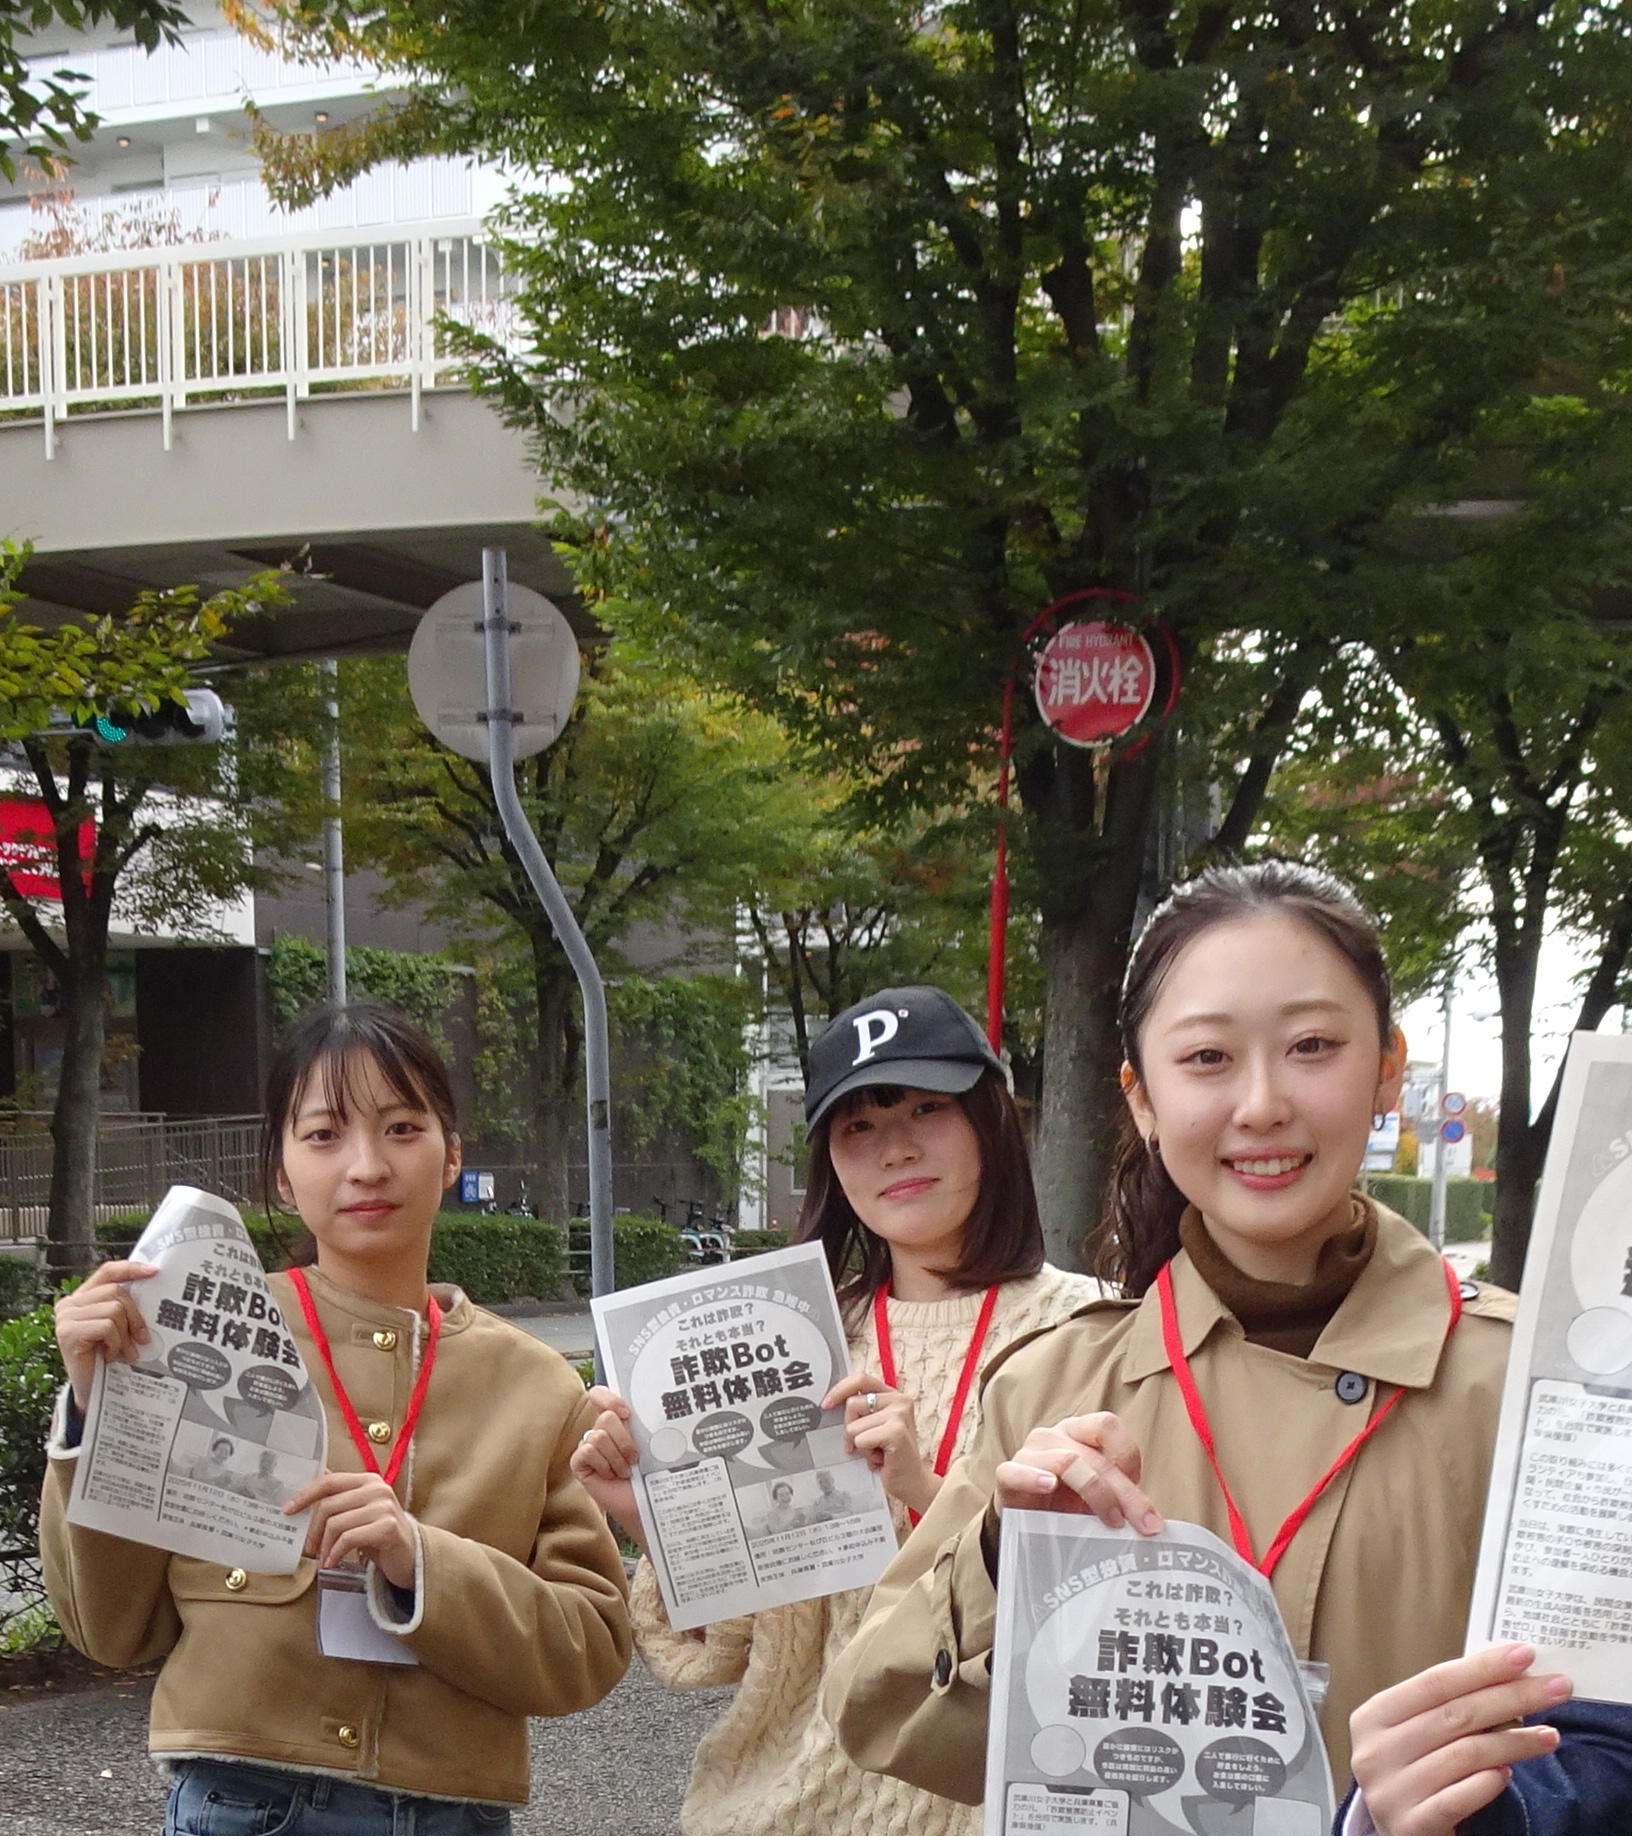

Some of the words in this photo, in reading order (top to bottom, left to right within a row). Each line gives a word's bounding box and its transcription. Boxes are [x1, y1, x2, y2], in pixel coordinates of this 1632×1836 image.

[1048, 654, 1144, 706] 消火栓
[852, 1008, 900, 1067] P
[182, 1272, 288, 1332] 詐欺Bo
[670, 1333, 790, 1386] 詐欺Bot
[661, 1360, 814, 1420] 無料体験会
[1126, 1580, 1233, 1606] これは詐欺？
[1114, 1608, 1243, 1635] それとも本当？
[1097, 1629, 1265, 1683] 詐欺Bot
[1068, 1674, 1287, 1734] 無料体験会
